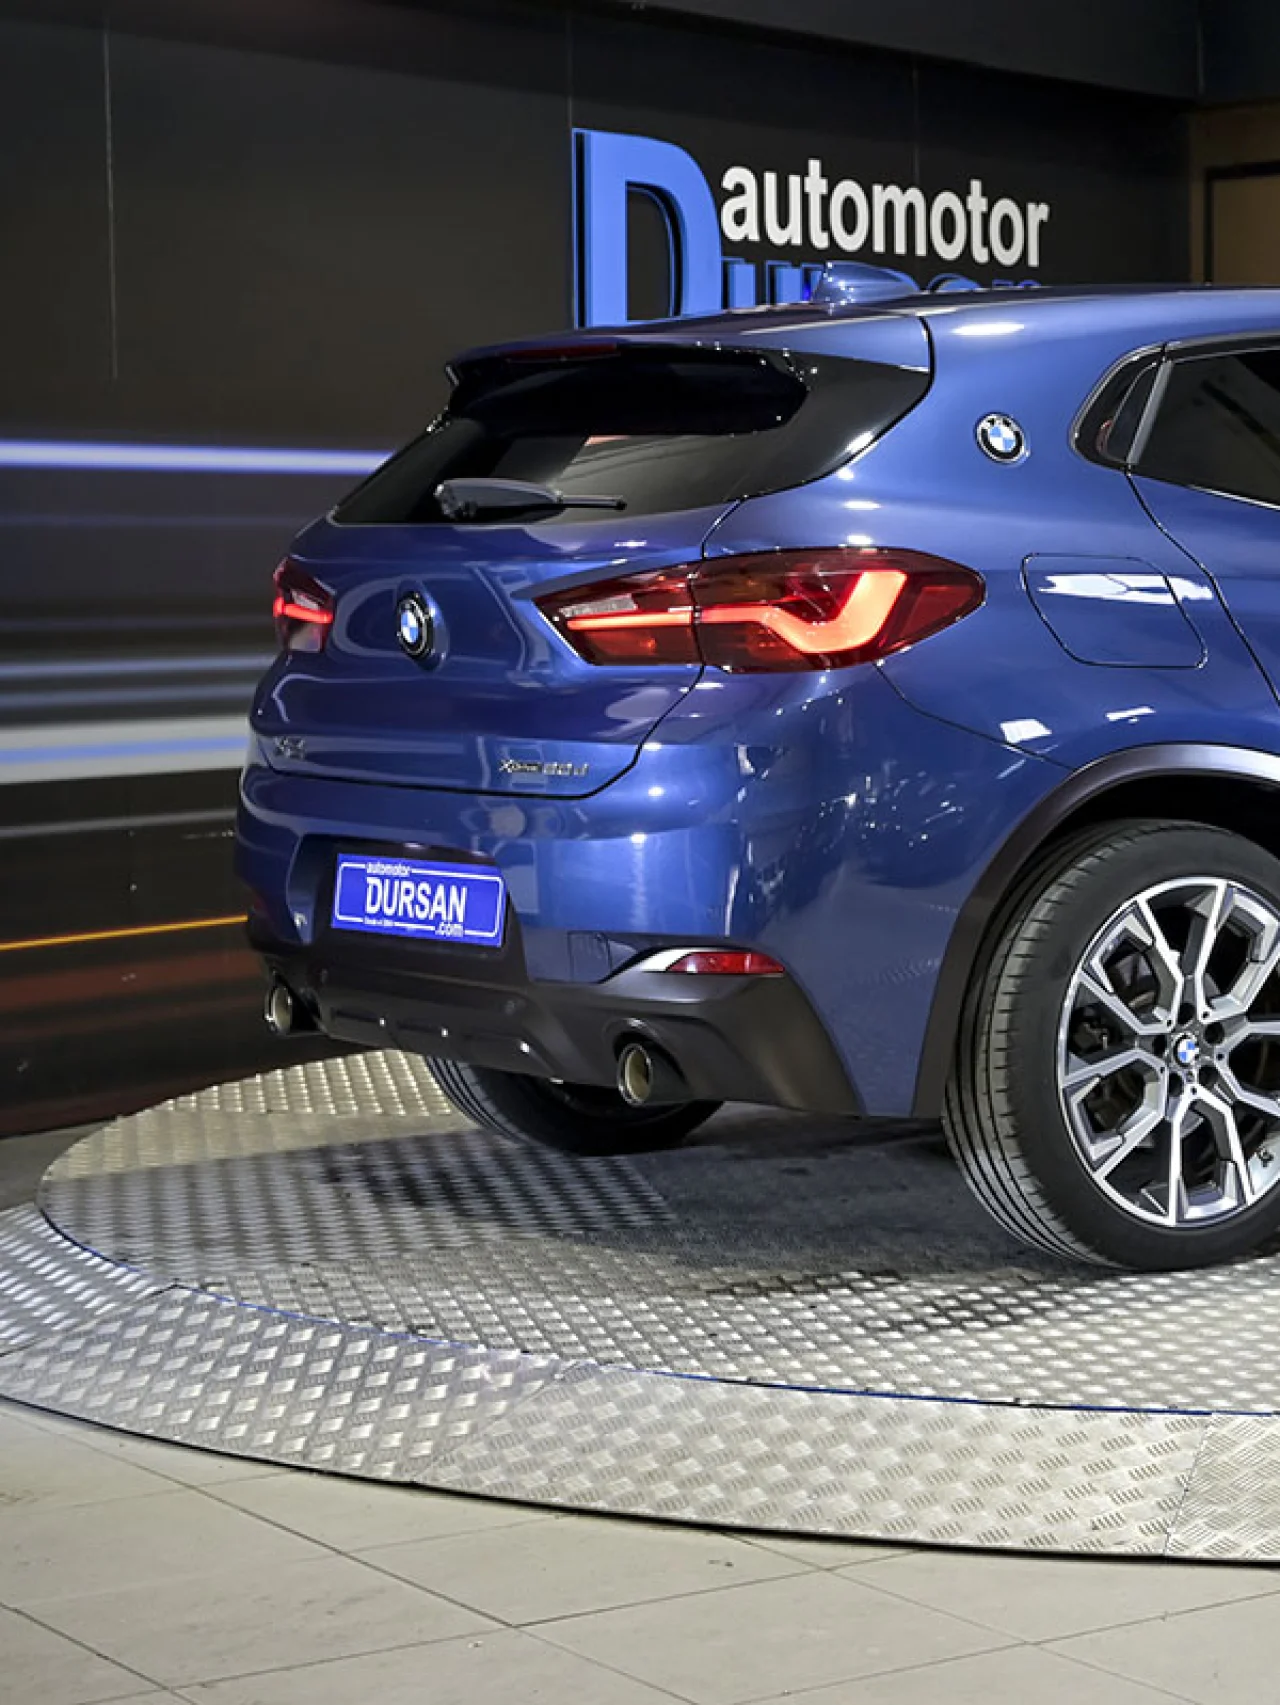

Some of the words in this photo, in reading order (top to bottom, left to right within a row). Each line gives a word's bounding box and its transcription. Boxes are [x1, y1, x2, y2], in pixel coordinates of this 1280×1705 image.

[721, 159, 1049, 267] automotor
[365, 876, 468, 923] DURSAN
[434, 921, 464, 937] .com
